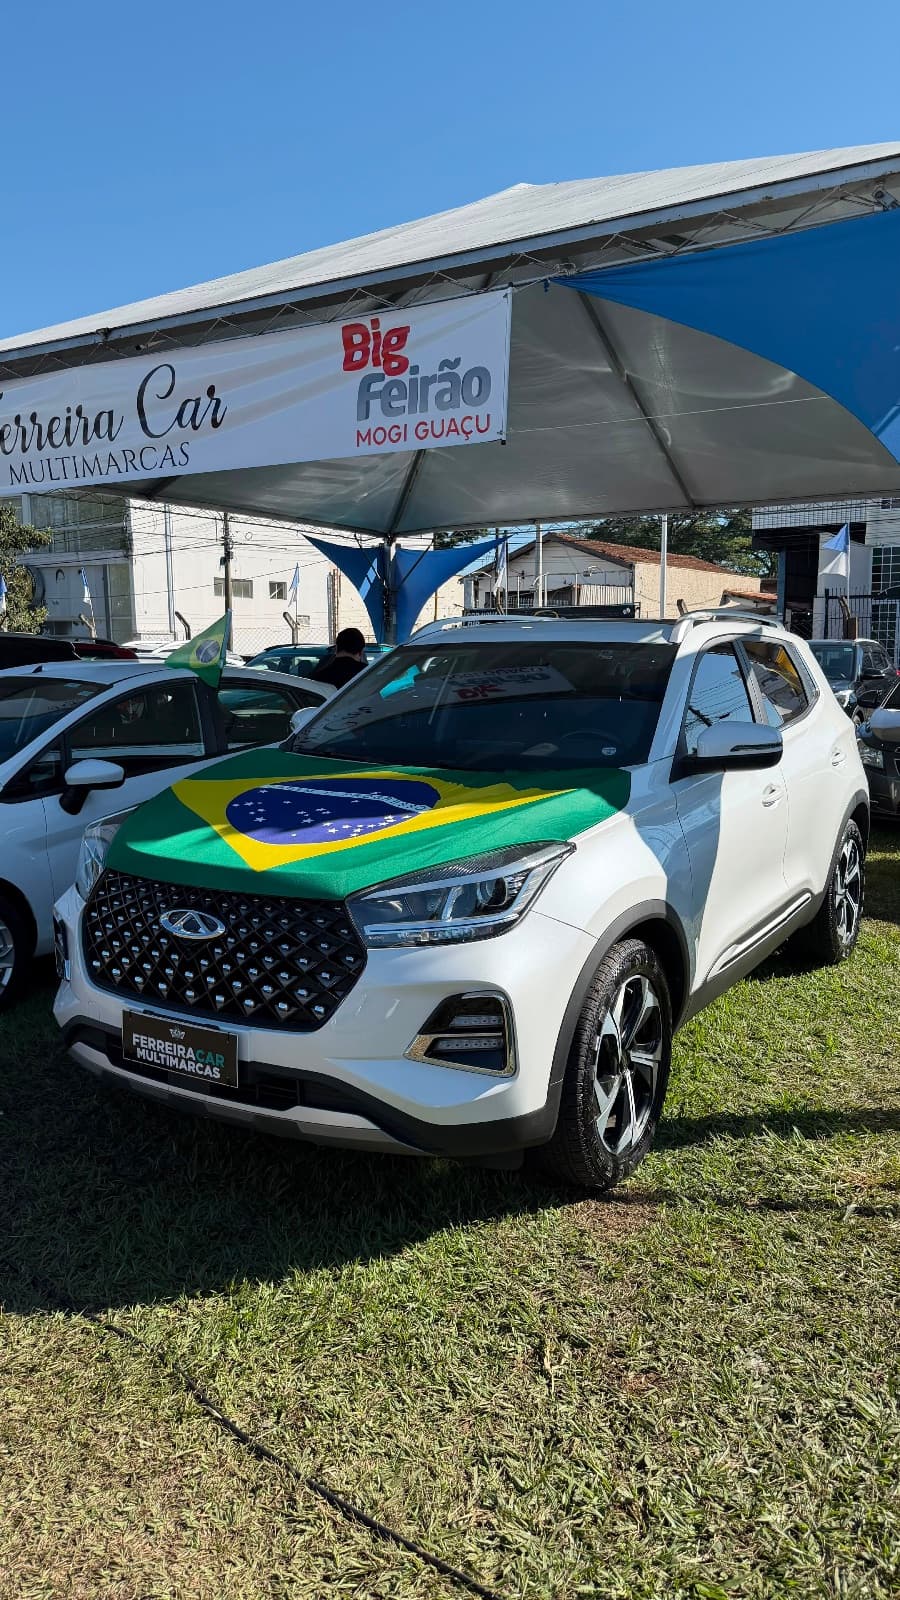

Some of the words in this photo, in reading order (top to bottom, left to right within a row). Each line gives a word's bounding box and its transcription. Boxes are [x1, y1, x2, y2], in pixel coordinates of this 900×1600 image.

[341, 317, 411, 377] Big
[0, 391, 124, 456] erreira
[136, 363, 228, 439] Car
[356, 356, 492, 422] Feirão
[356, 423, 408, 448] MOGI
[414, 413, 491, 441] GUAÇU
[9, 441, 190, 486] MULTIMARCAS
[137, 1048, 220, 1078] MULTIMARCAS
